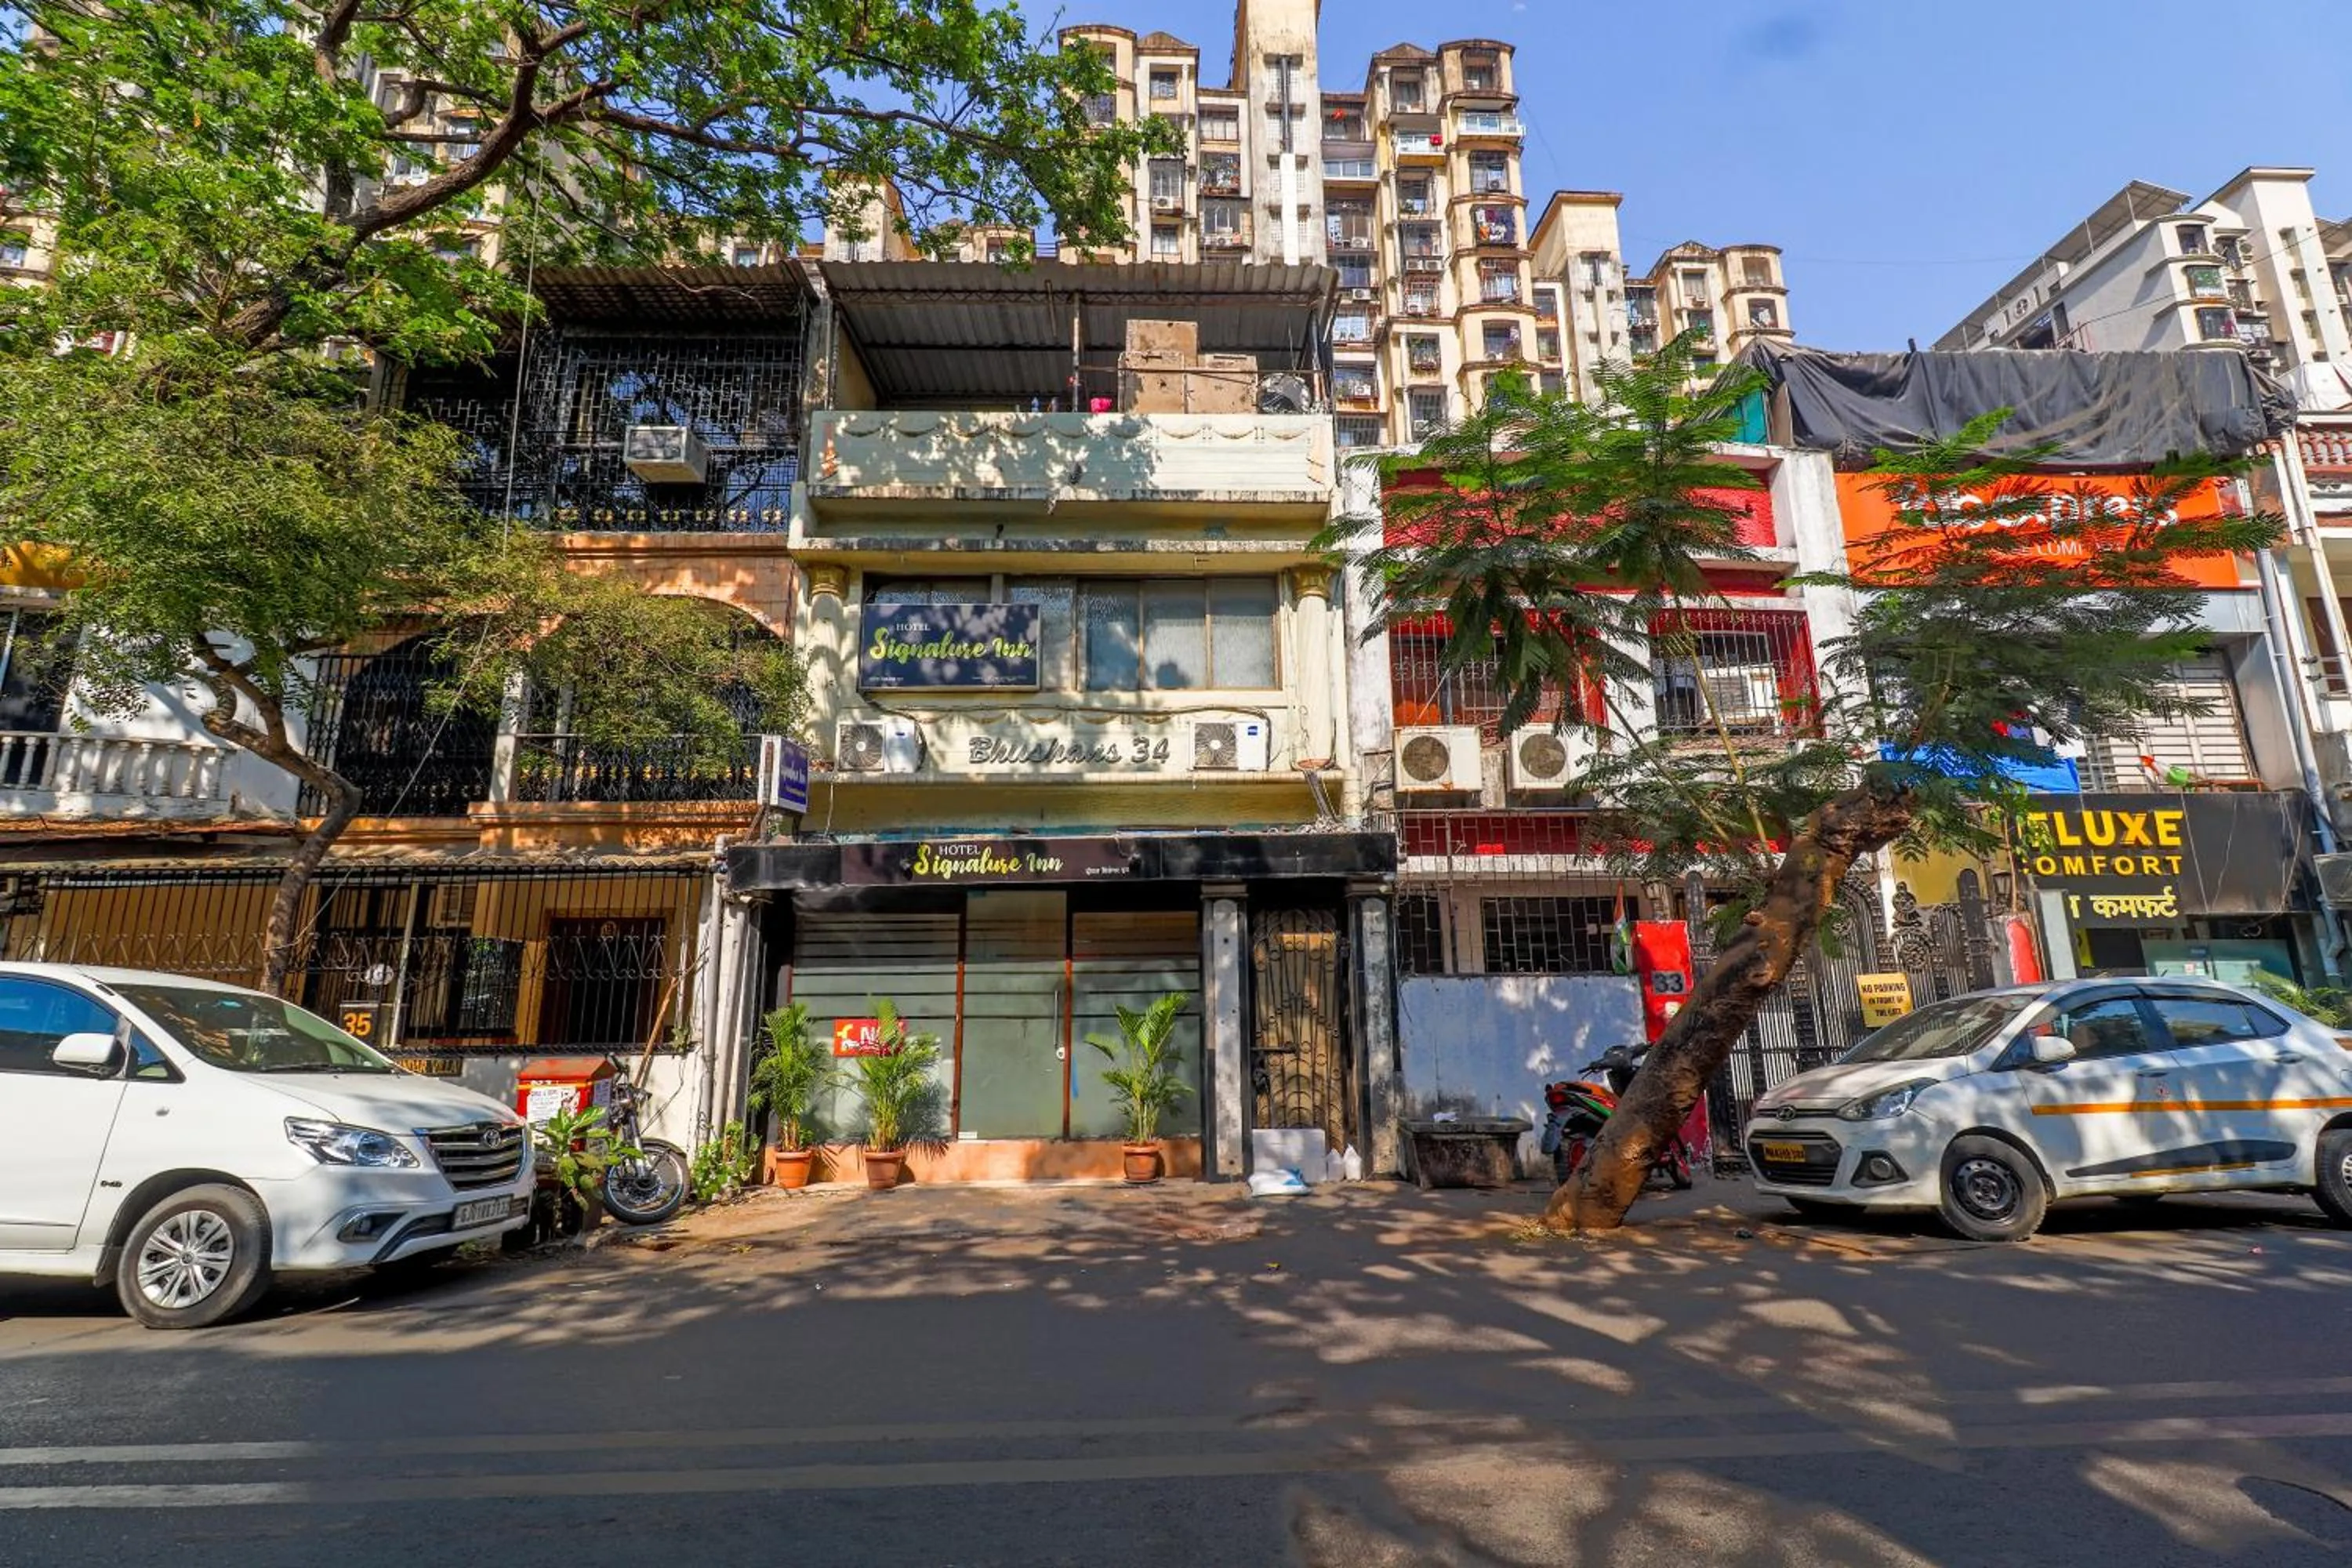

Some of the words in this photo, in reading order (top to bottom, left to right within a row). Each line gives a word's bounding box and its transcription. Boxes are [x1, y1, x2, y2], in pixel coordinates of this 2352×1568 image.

[895, 622, 931, 632] HOTEL
[992, 637, 1033, 659] Inn
[1131, 736, 1171, 764] 34
[938, 844, 981, 855] HOTEL
[1025, 852, 1064, 873] Inn
[1654, 973, 1683, 993] 33
[343, 1012, 372, 1036] 35
